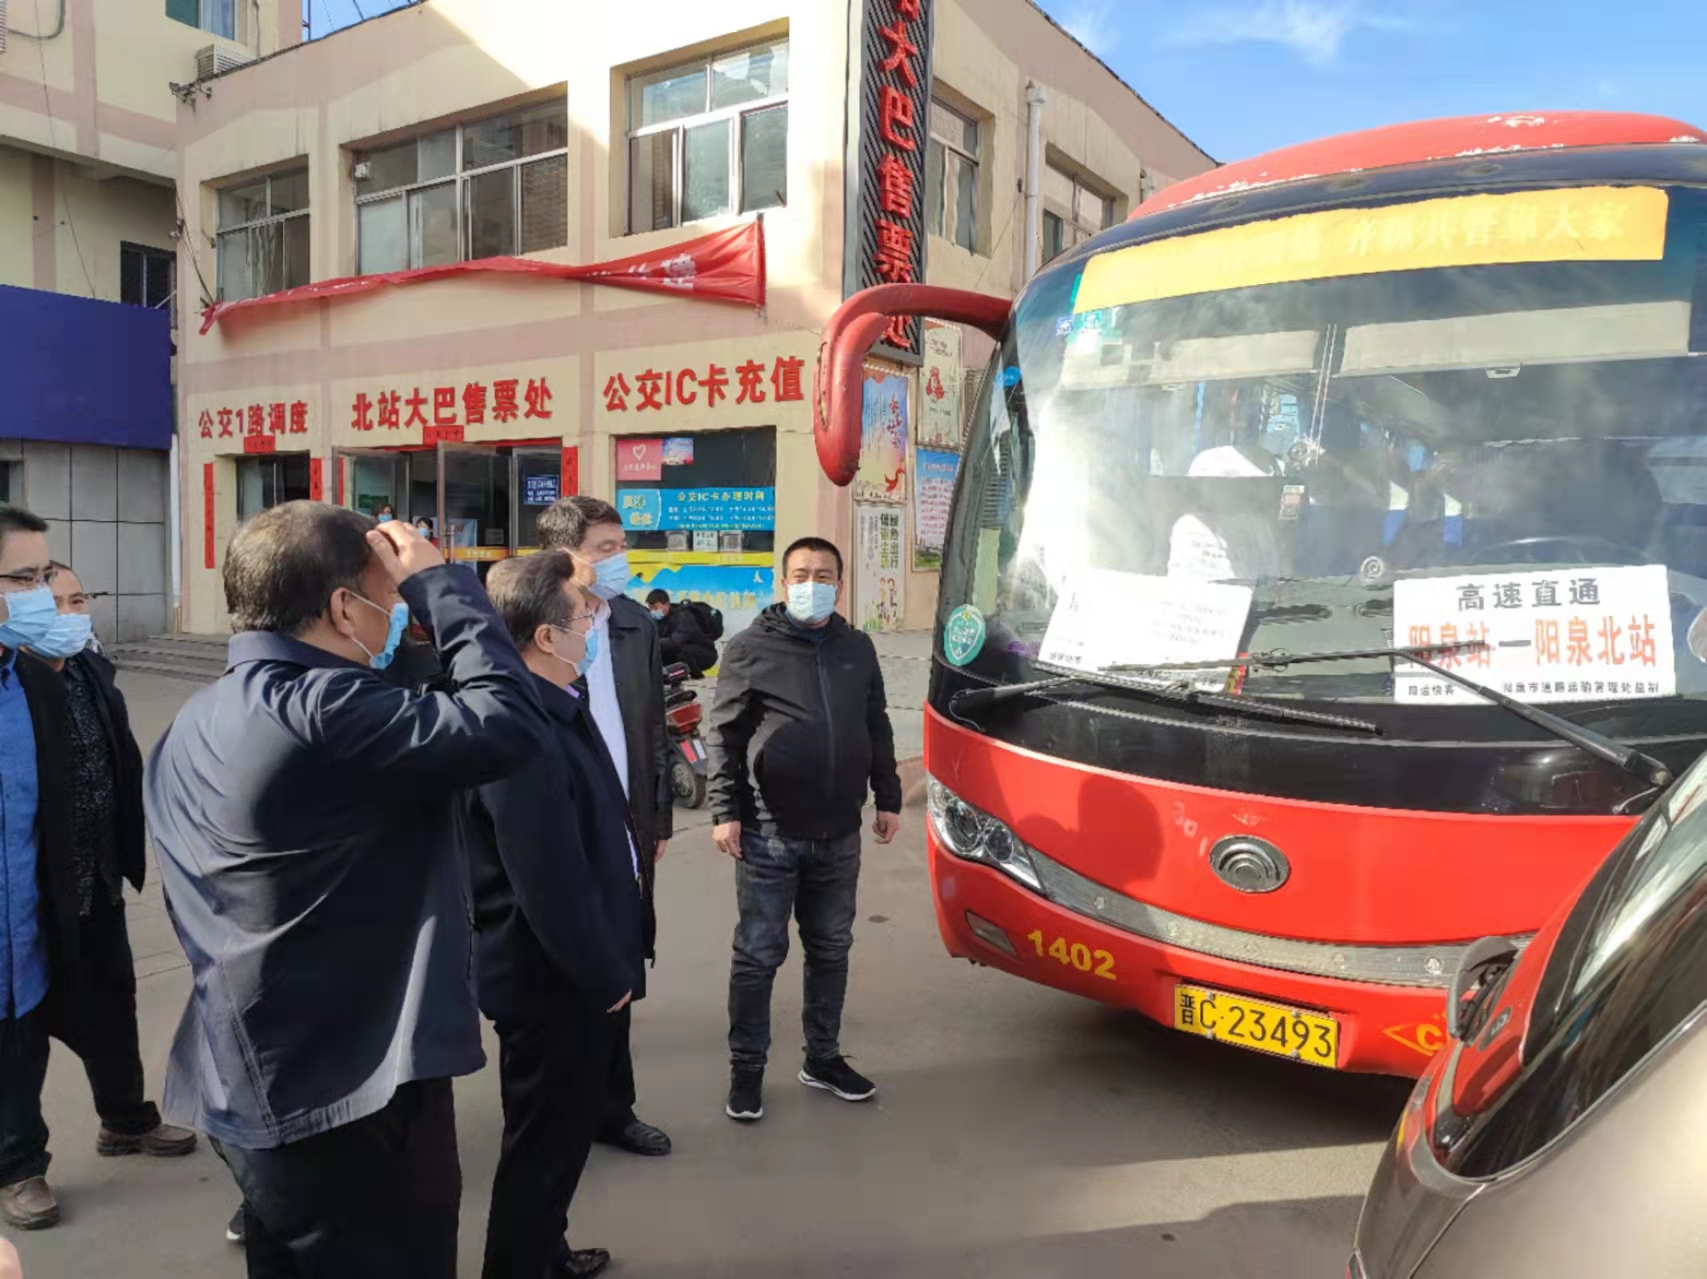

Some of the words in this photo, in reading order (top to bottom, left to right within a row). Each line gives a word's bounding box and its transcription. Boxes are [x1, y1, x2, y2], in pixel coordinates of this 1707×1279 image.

[351, 376, 553, 432] 北站大巴售票处
[602, 355, 804, 413] 公交IC卡充值
[198, 400, 308, 439] 公交1路调度
[1456, 577, 1601, 612] 高速直通
[1027, 929, 1117, 981] 1402
